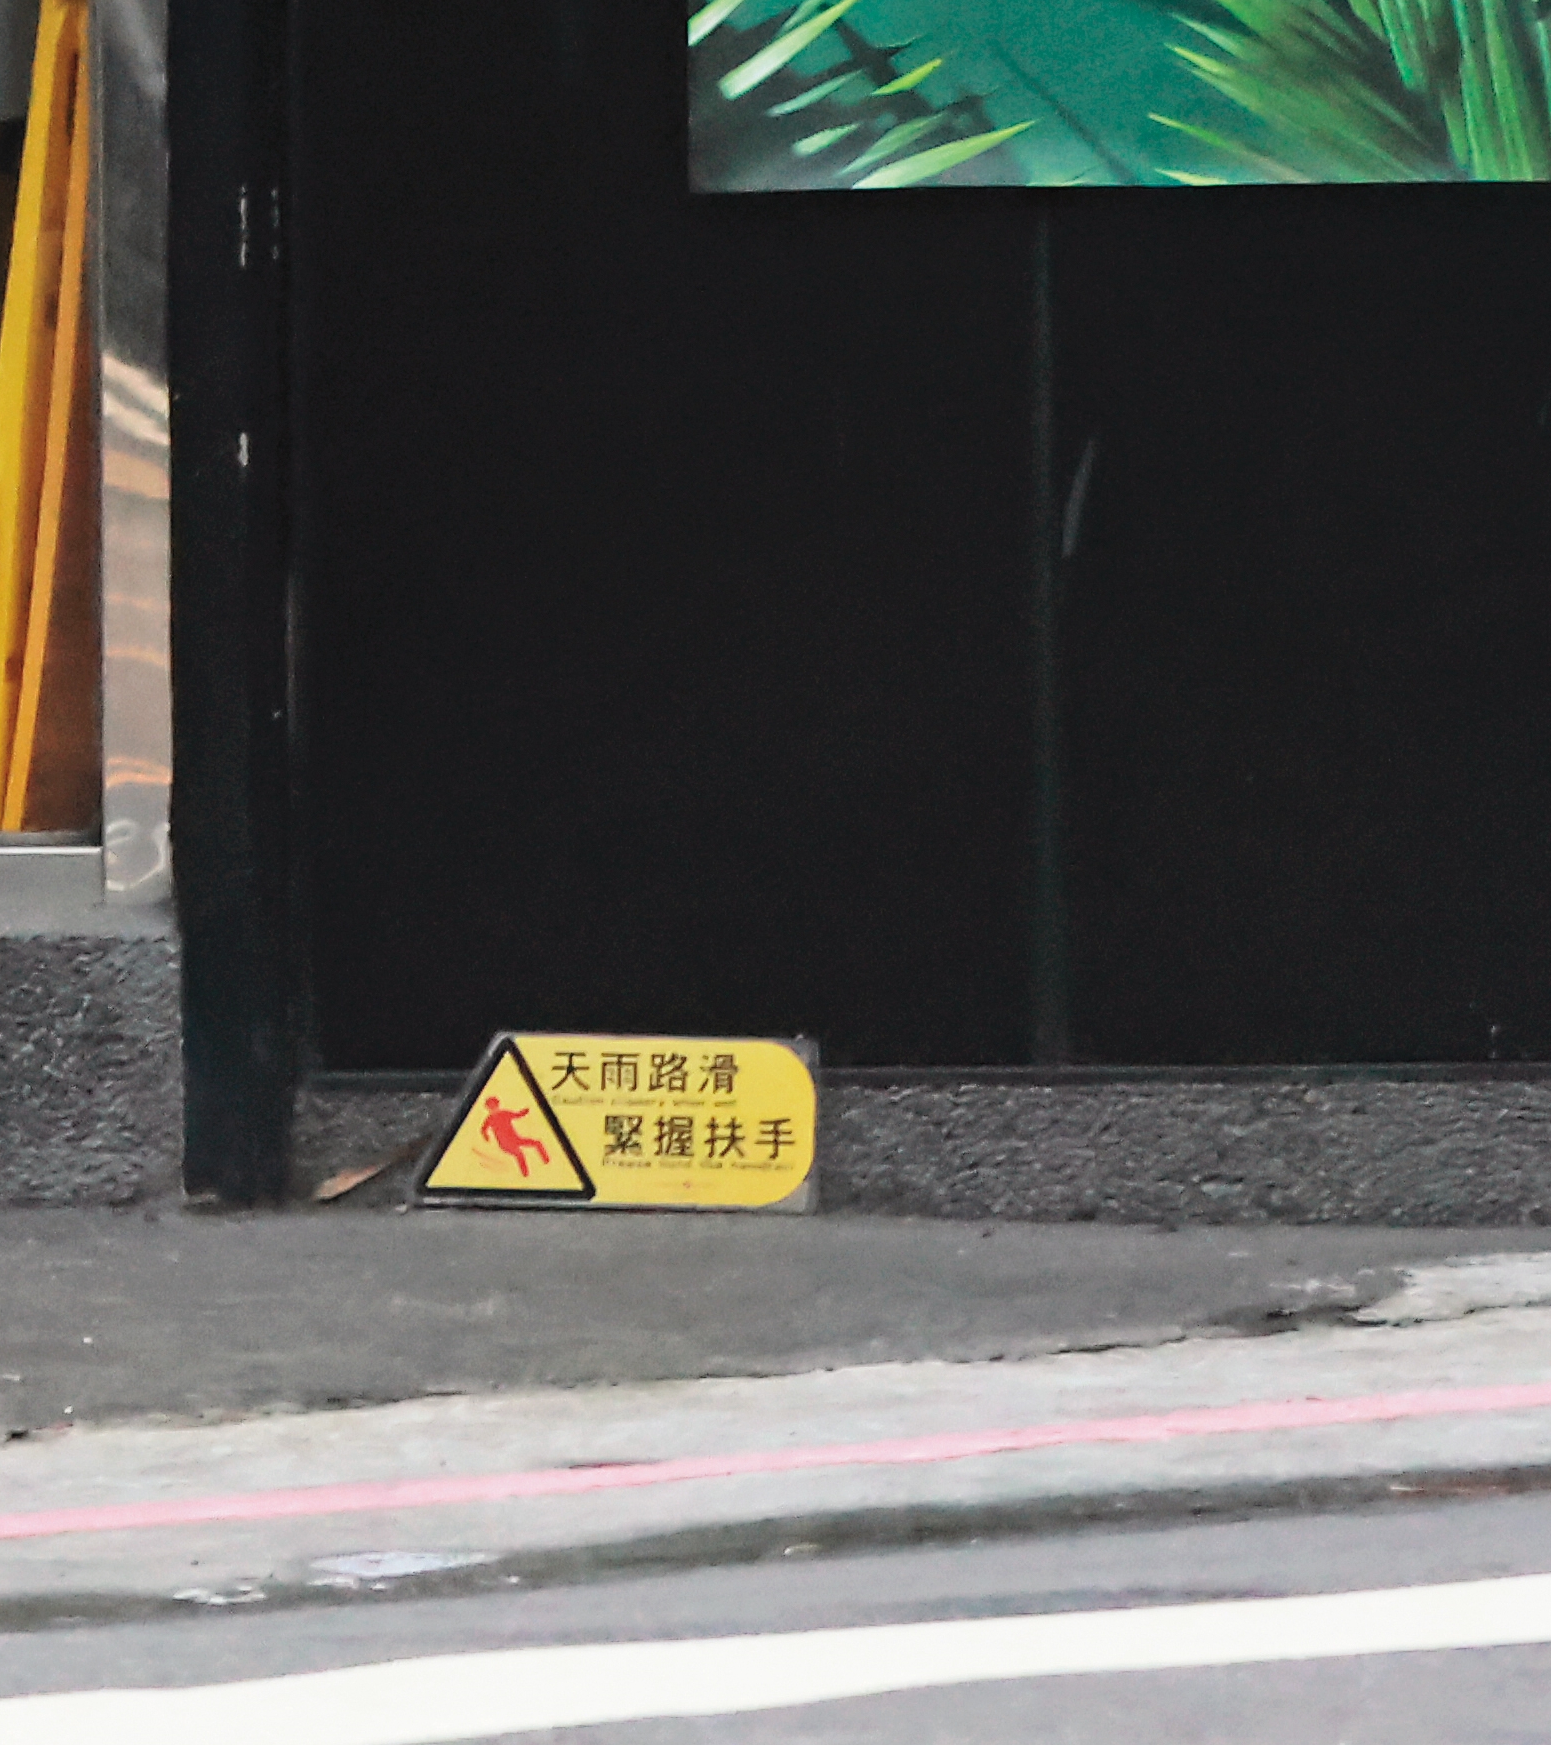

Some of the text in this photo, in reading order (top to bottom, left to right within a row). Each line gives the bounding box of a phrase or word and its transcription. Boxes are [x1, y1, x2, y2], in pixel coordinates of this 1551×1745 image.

[551, 1051, 739, 1094] 天雨路滑
[603, 1114, 796, 1160] 緊握扶手
